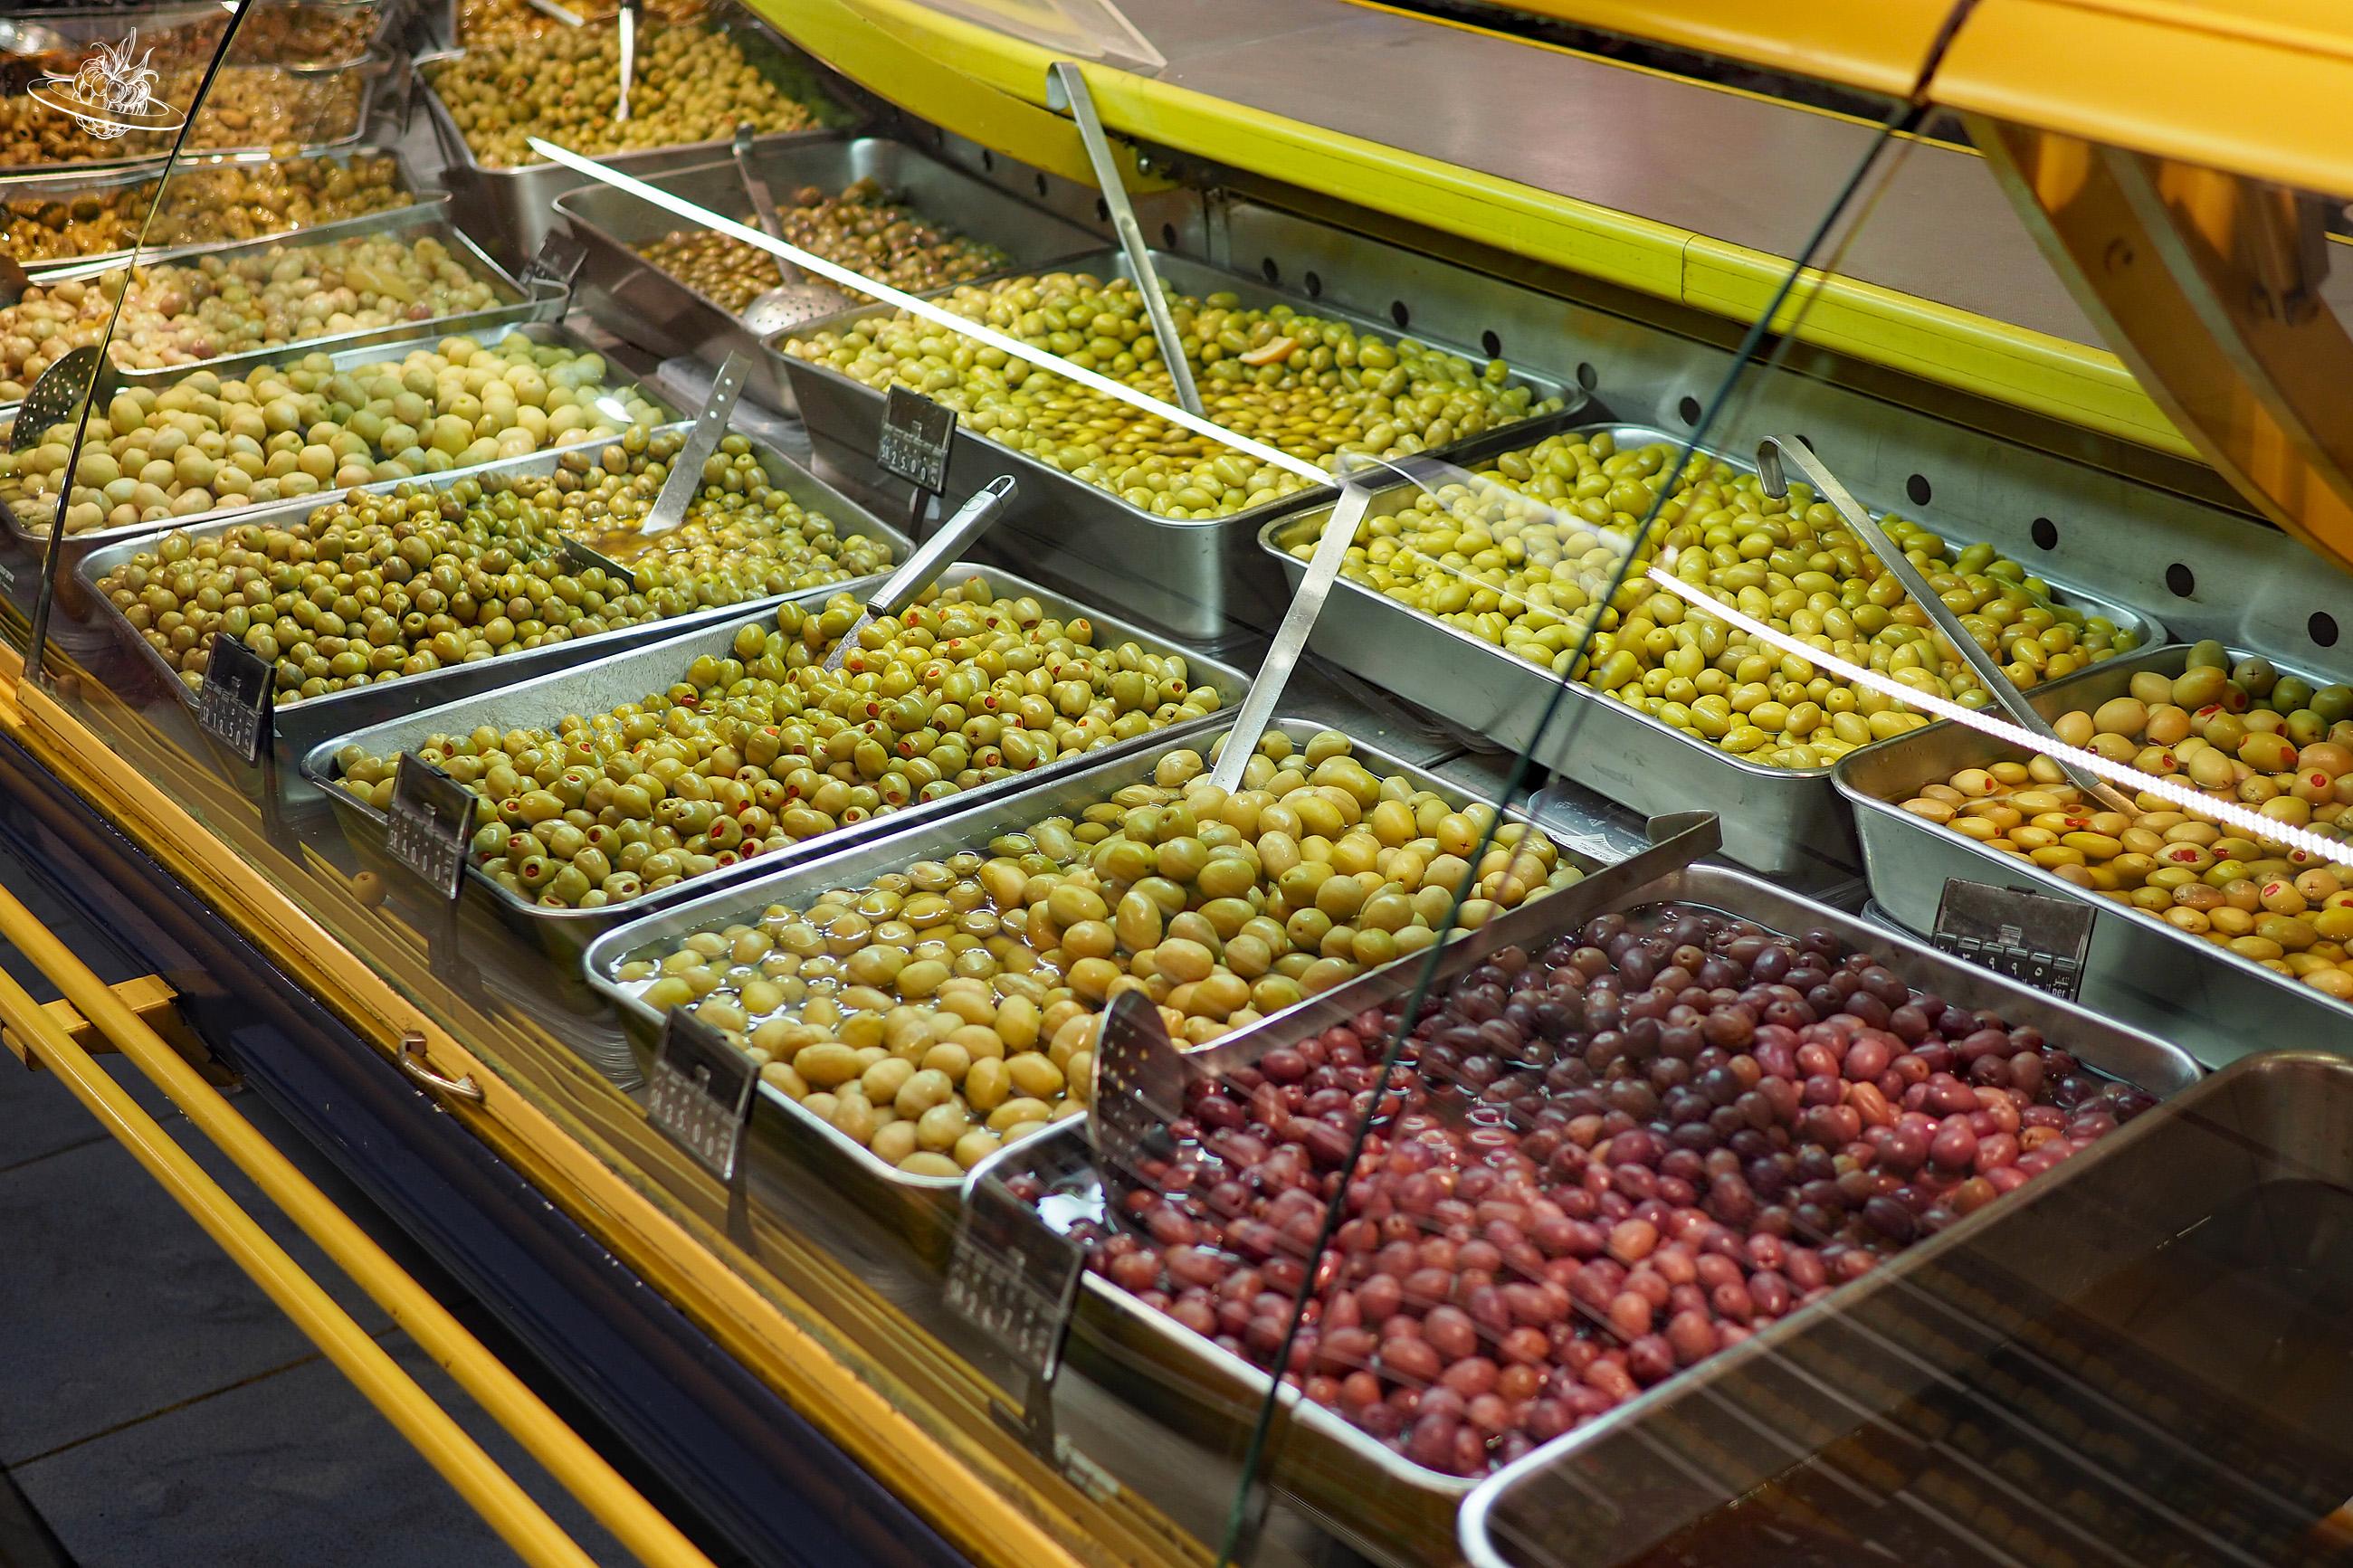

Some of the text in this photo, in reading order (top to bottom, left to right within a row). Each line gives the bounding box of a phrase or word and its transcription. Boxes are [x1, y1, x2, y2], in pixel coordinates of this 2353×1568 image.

[891, 451, 927, 480] 25.00
[213, 712, 242, 746] 18.50
[401, 839, 441, 881] 40.00
